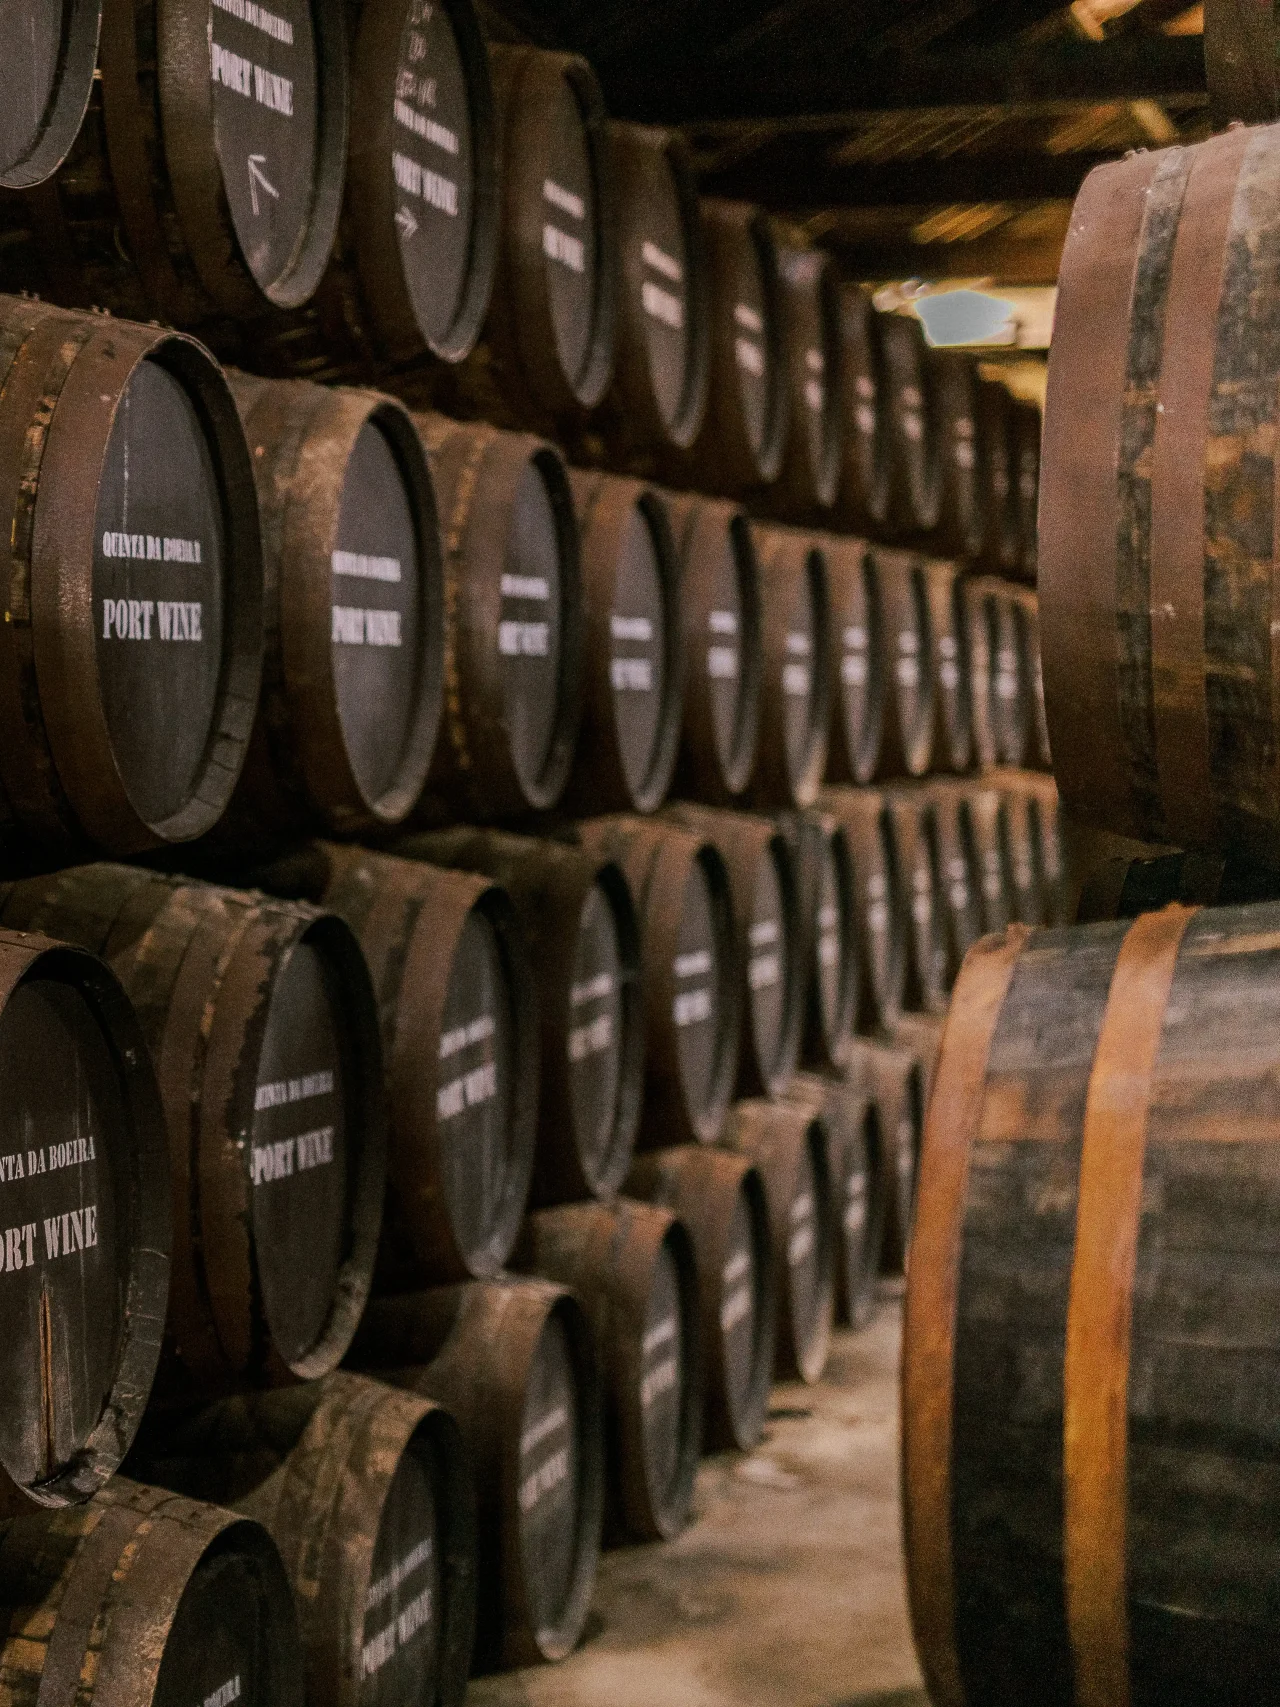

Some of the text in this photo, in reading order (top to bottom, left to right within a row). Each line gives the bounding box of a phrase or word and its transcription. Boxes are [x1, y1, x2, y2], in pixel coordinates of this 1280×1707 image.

[102, 598, 203, 642] PORT WINE
[27, 1148, 47, 1176] DA
[48, 1136, 96, 1171] BOEIRA
[43, 1205, 98, 1260] WINE
